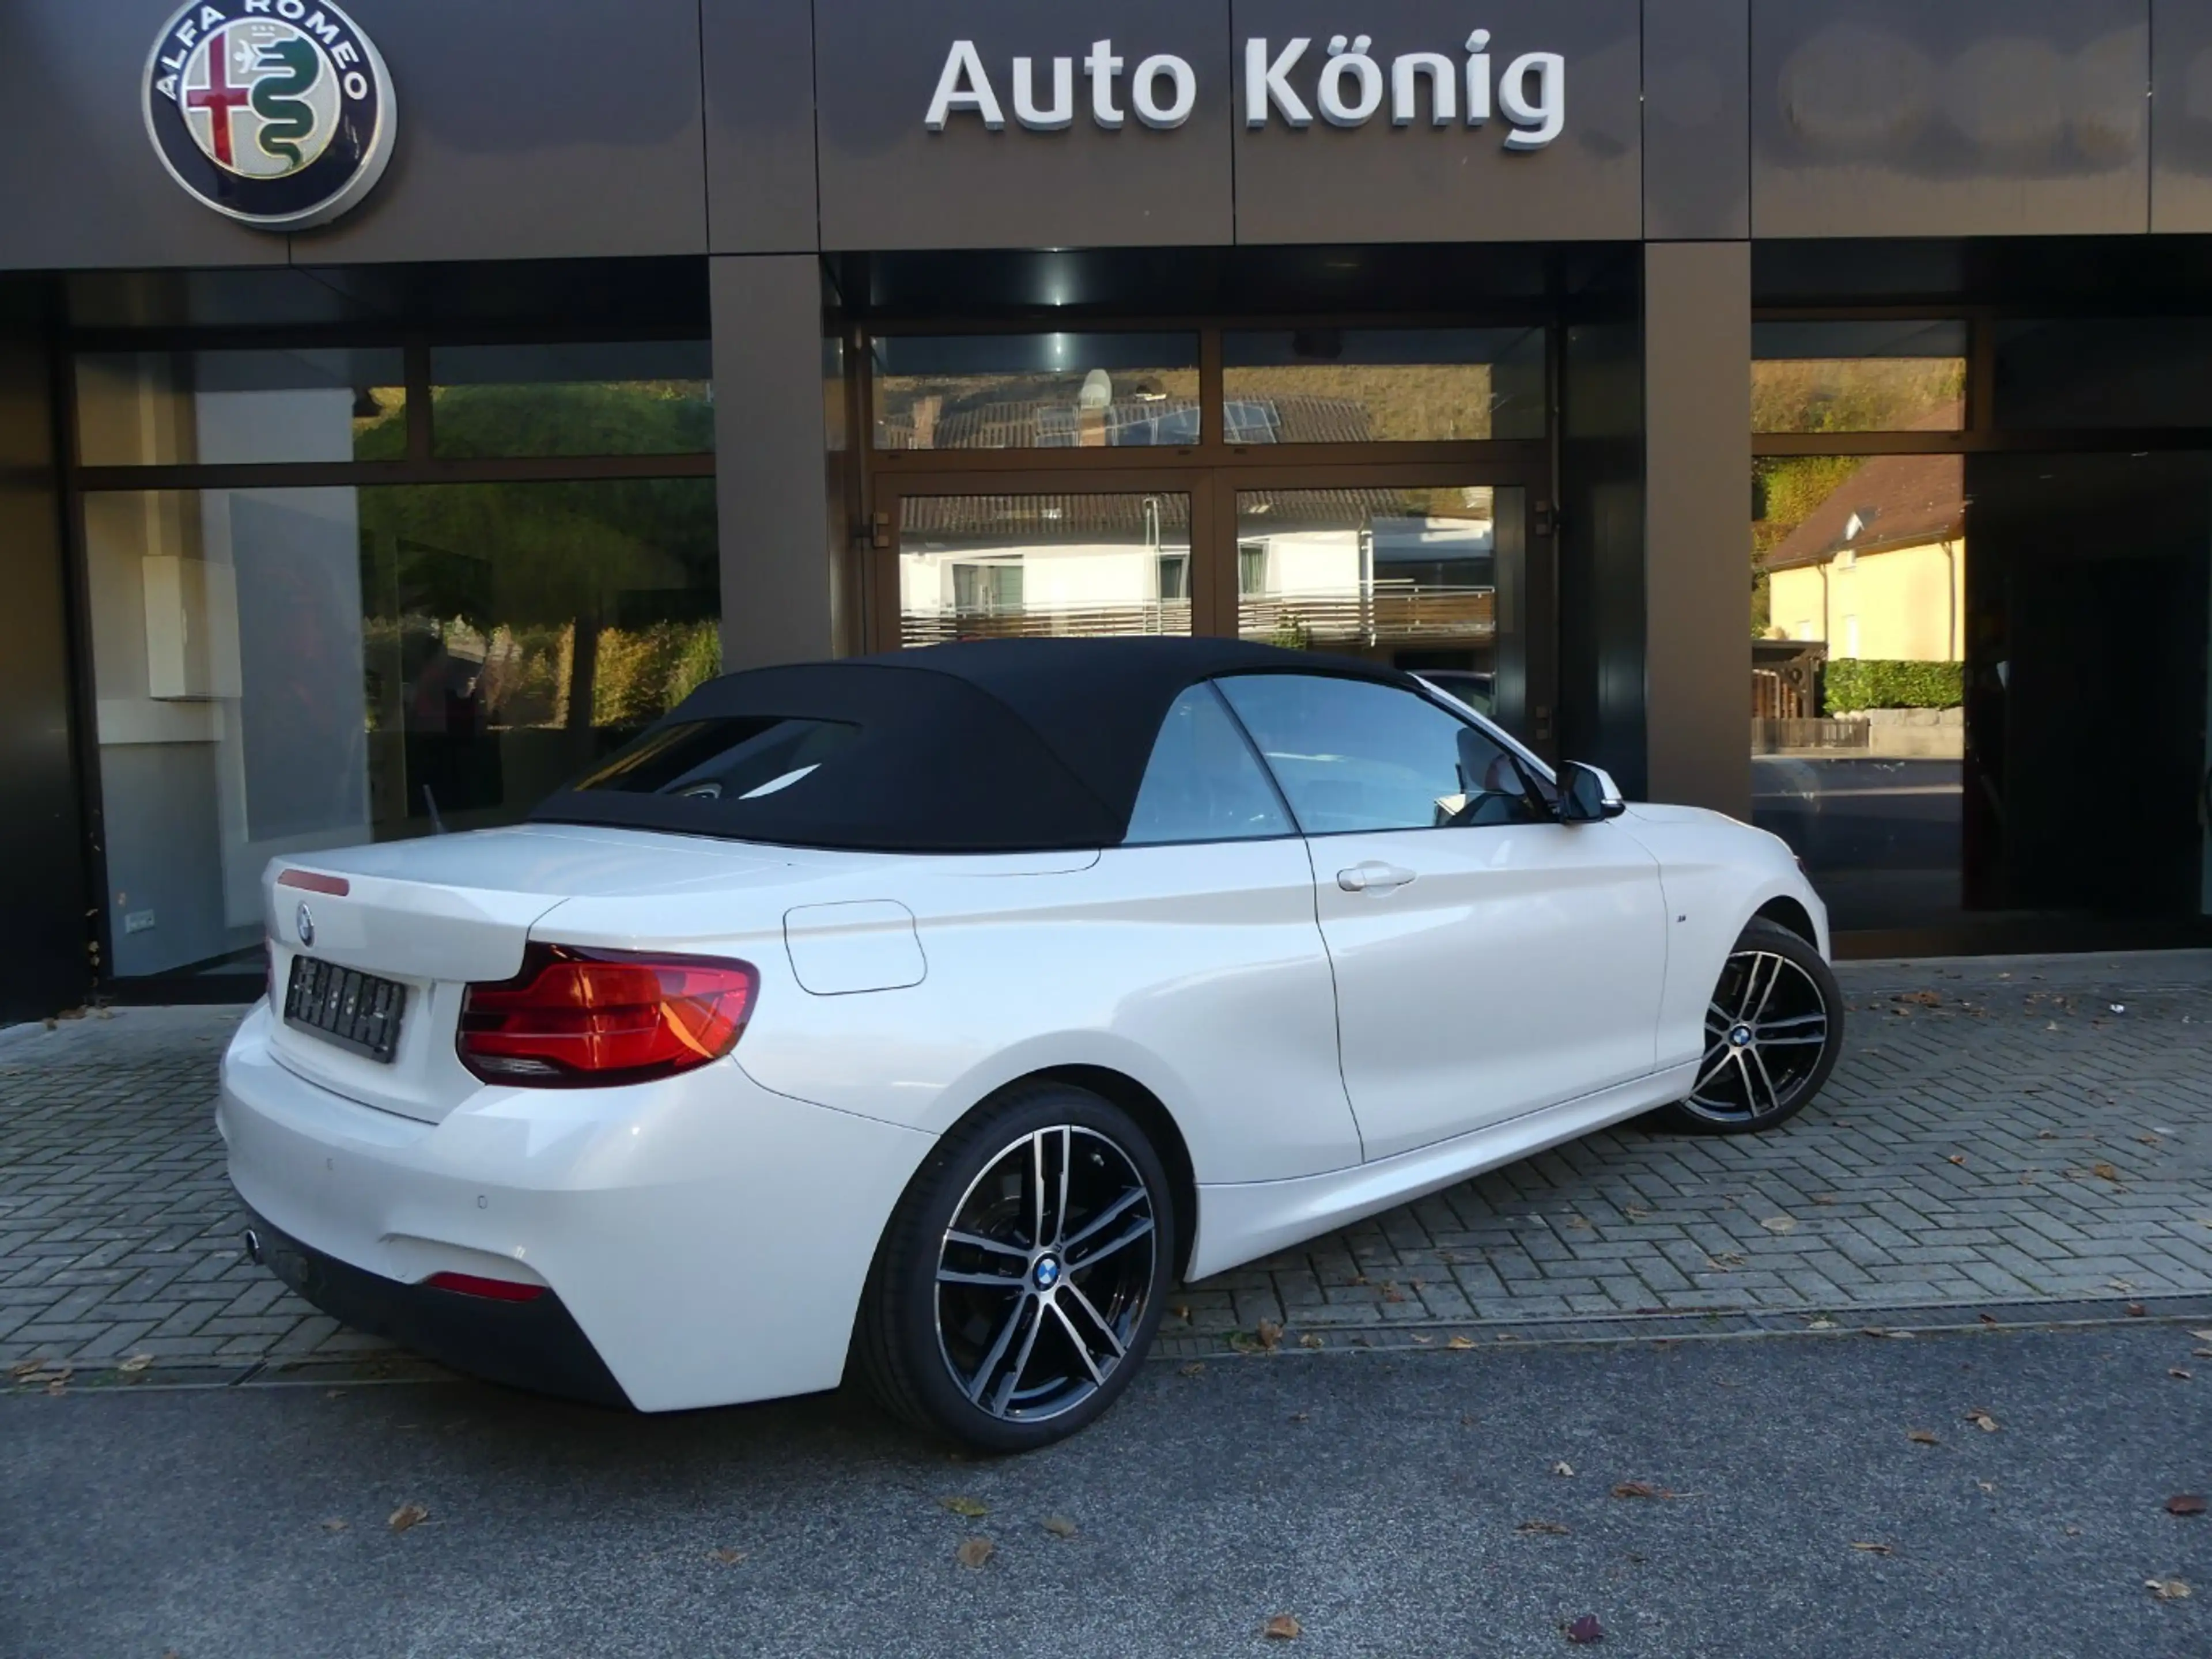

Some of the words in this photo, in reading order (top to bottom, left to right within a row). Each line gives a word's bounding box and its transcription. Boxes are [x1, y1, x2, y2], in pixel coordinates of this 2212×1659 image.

[156, 5, 225, 100] ALFA
[245, 0, 368, 100] ROMEO
[924, 39, 1197, 131] Auto
[1245, 28, 1564, 151] König
